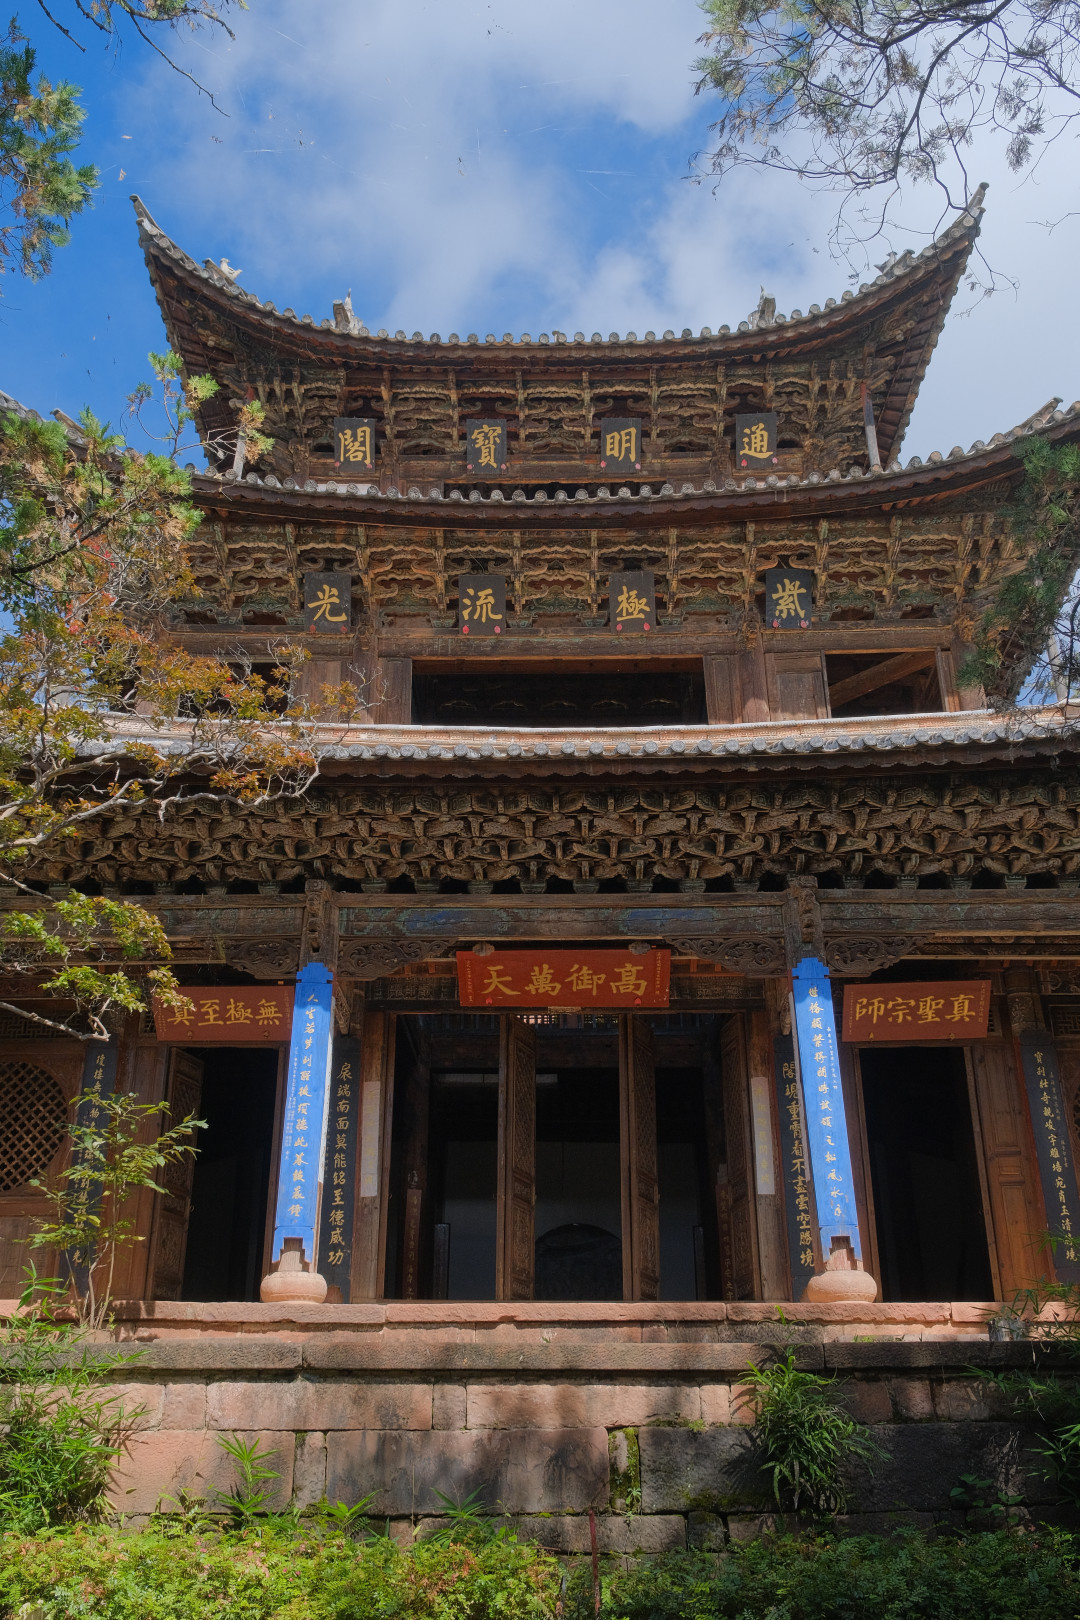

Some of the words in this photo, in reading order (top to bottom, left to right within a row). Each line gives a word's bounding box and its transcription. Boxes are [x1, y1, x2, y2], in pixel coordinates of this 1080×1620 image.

[339, 426, 371, 465] 閣
[606, 427, 636, 463] 明
[740, 425, 773, 460] 通
[308, 584, 347, 622] 光
[463, 588, 503, 623] 流
[616, 585, 650, 622] 極
[772, 578, 807, 619] 紫
